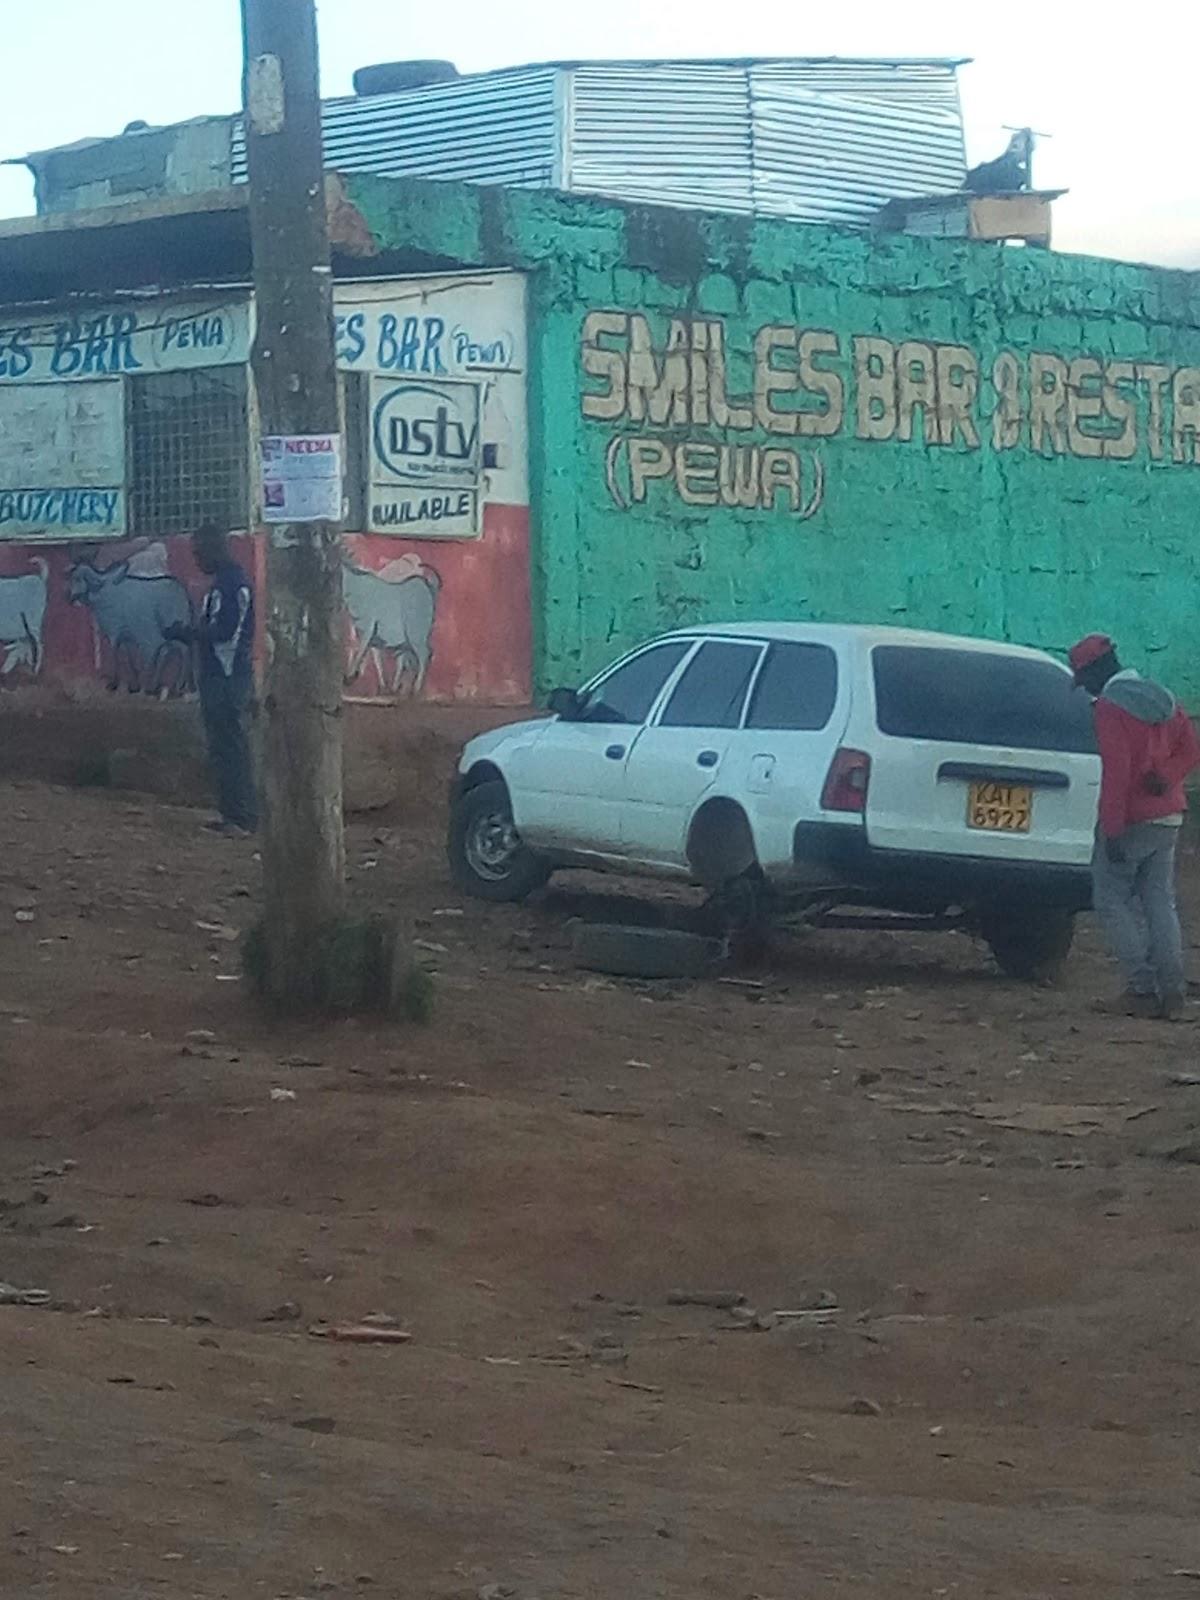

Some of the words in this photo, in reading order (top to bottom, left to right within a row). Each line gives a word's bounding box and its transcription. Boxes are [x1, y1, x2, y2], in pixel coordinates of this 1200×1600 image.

[50, 311, 142, 376] BAR
[377, 313, 448, 373] BAR
[580, 309, 844, 437] SMILES
[852, 334, 981, 449] BAR
[0, 489, 118, 524] BUTCHERY
[605, 436, 824, 520] (PEWA)
